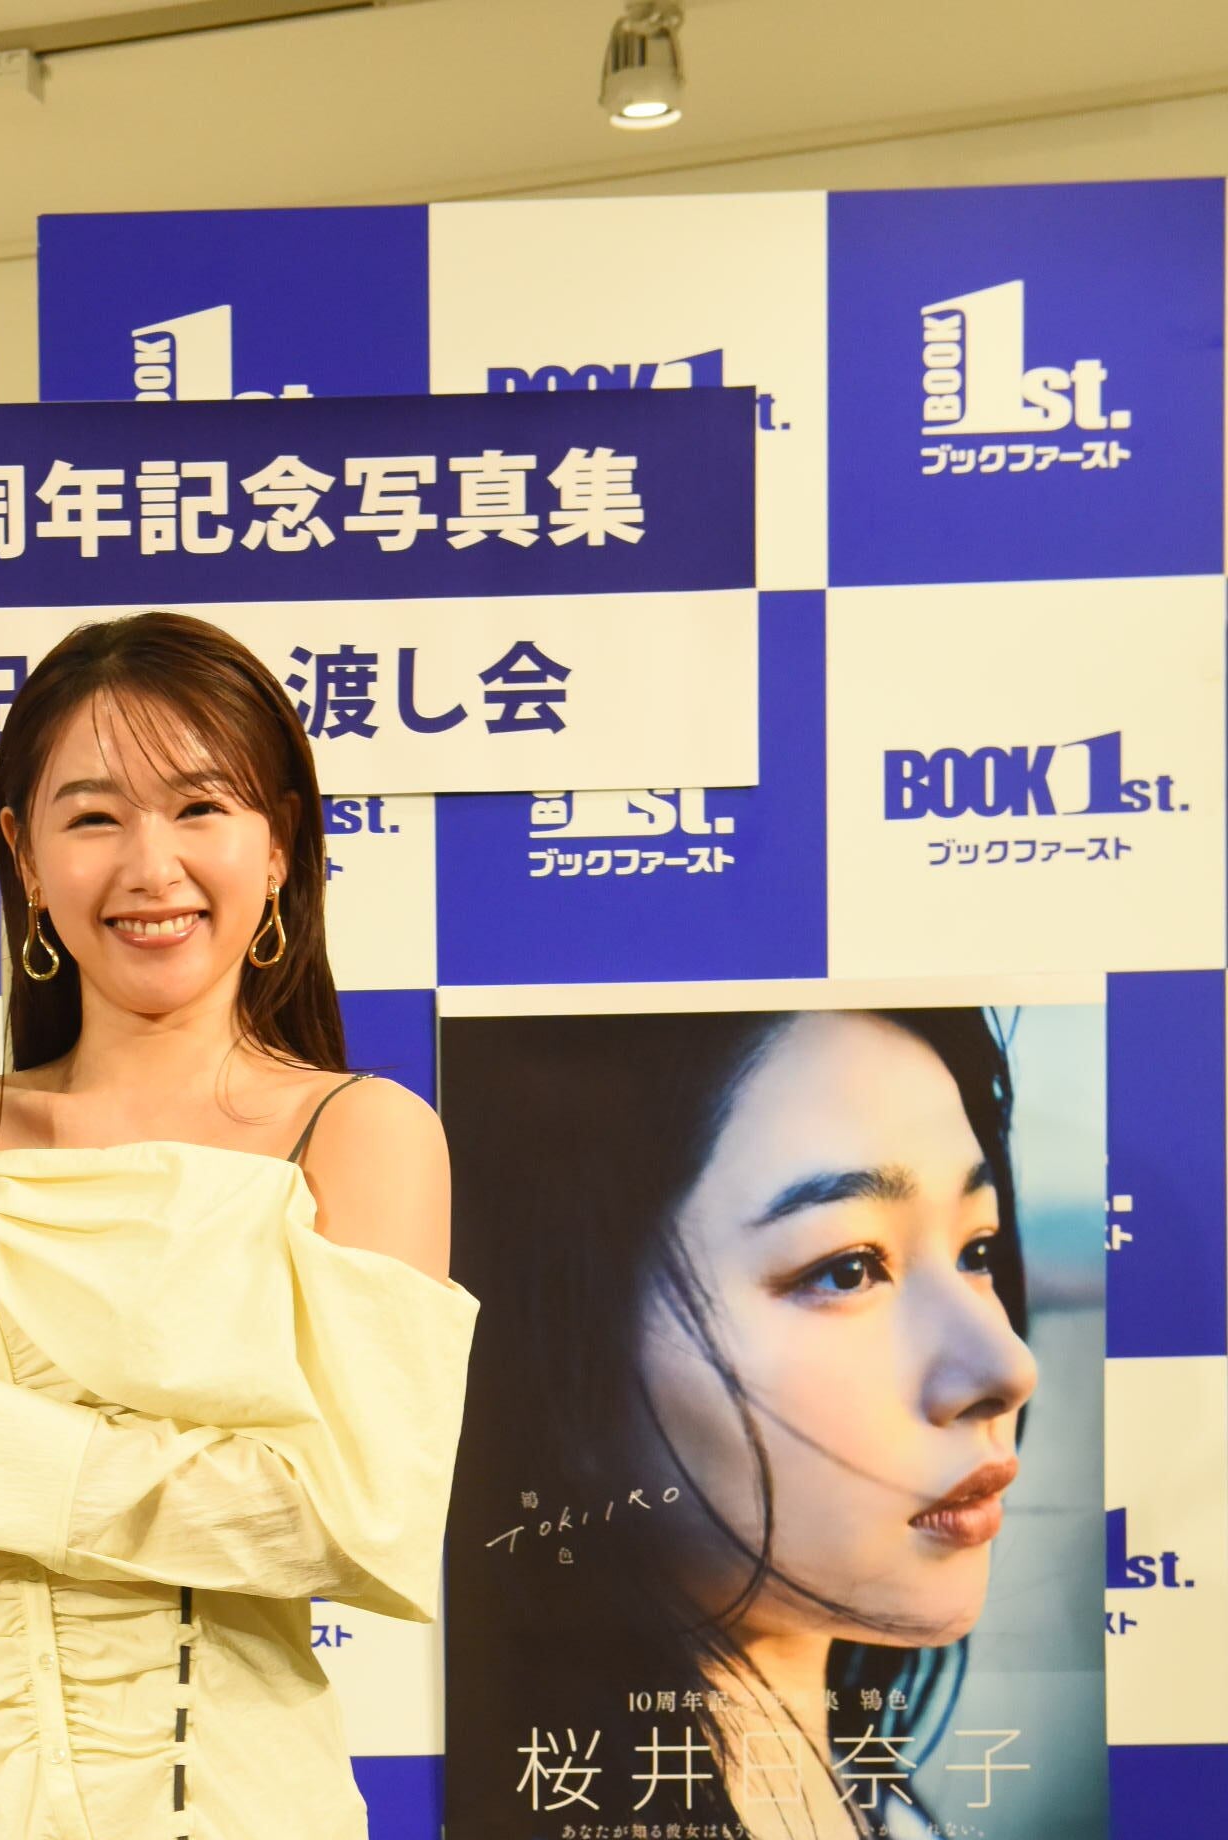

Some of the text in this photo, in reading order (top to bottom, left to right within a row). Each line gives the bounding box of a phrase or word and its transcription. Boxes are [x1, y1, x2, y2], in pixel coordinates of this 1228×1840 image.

[921, 443, 1130, 476] ブックファースト
[529, 848, 735, 878] ブックファースト
[927, 838, 1131, 867] ブックファースト
[516, 1723, 1032, 1813] 桜井日奈子
